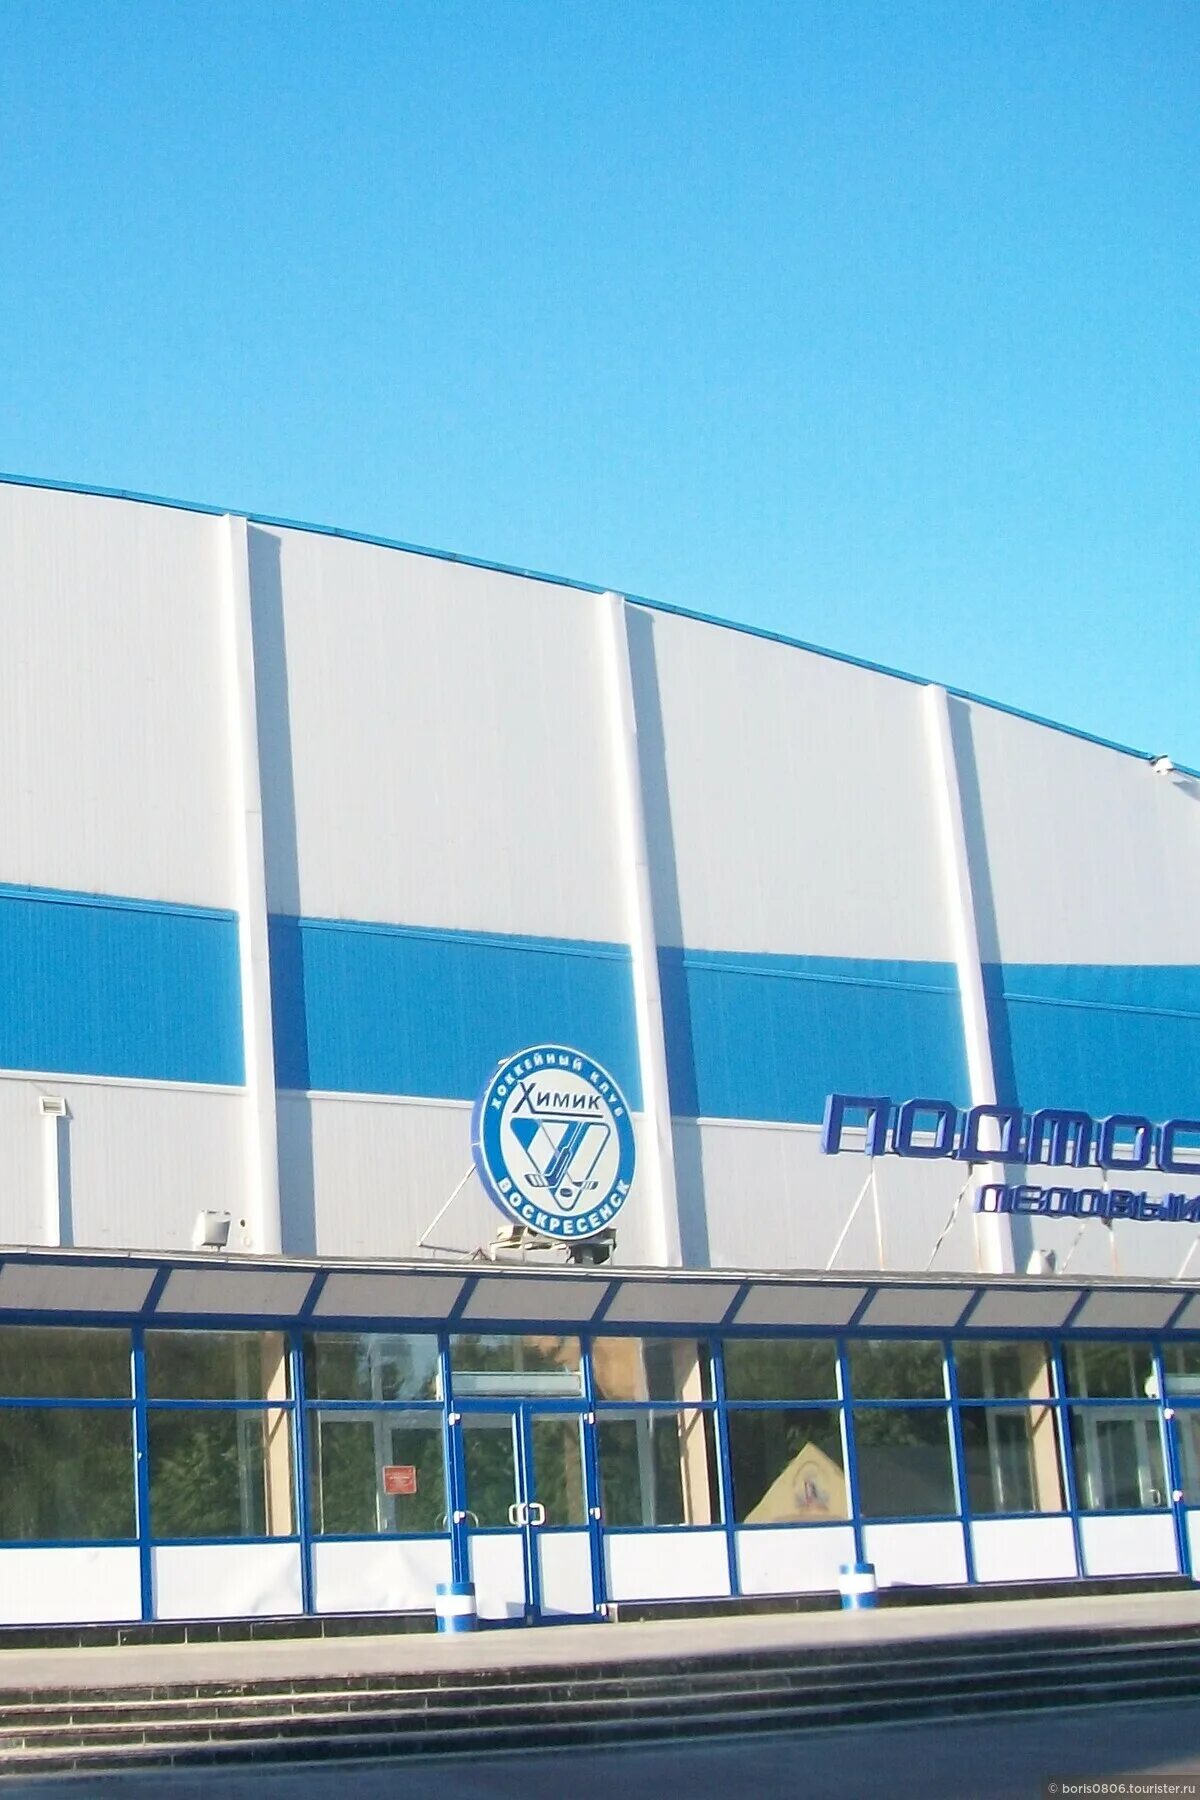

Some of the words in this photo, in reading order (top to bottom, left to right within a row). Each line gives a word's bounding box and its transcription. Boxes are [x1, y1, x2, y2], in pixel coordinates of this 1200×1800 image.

[491, 1052, 583, 1110] ХОККЕЙНЫЙ
[590, 1071, 624, 1117] КЛУБ
[497, 1177, 632, 1235] ВОСКРЕСЕНСК
